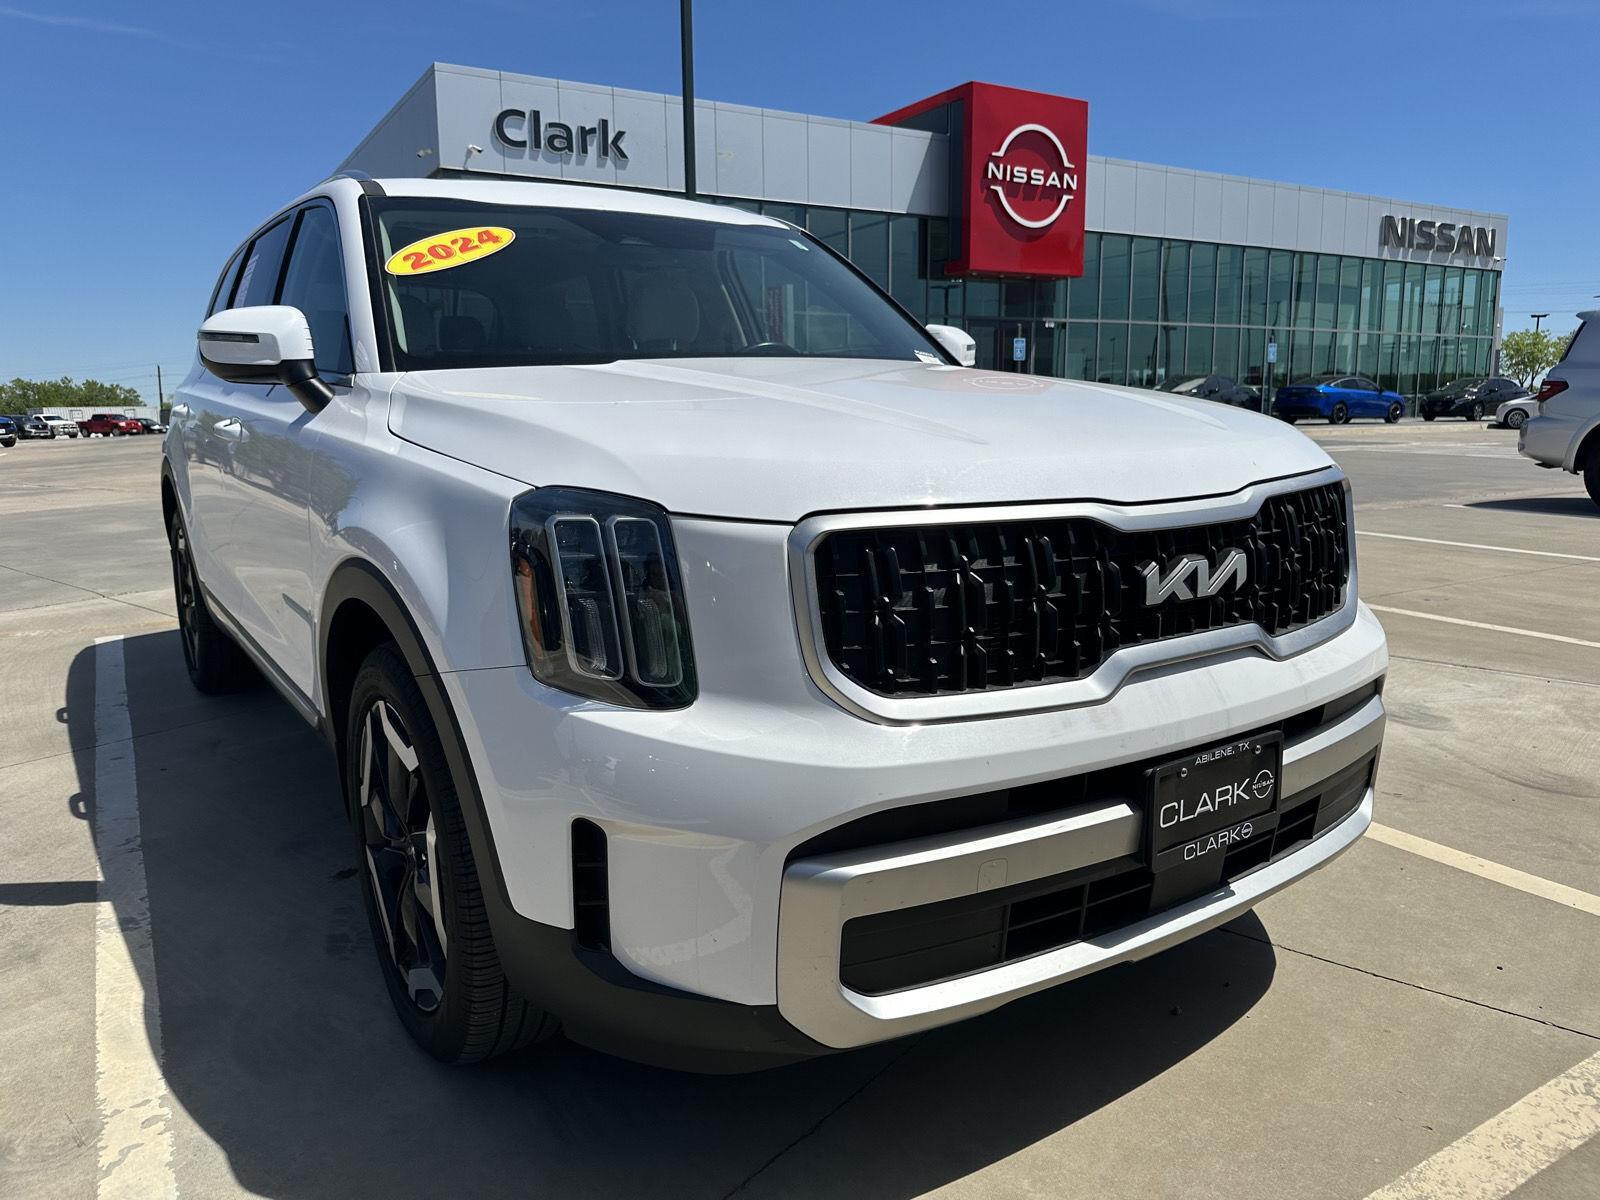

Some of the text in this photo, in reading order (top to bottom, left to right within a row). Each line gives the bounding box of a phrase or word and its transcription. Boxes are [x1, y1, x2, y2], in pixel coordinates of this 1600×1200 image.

[494, 108, 629, 160] Clark
[987, 161, 1078, 191] NISSAN
[402, 229, 502, 271] 2024
[1380, 214, 1497, 257] NISSAN
[1194, 741, 1250, 766] ABILENE, TX
[1160, 777, 1250, 828] CLARK
[1183, 826, 1241, 861] CLARK
